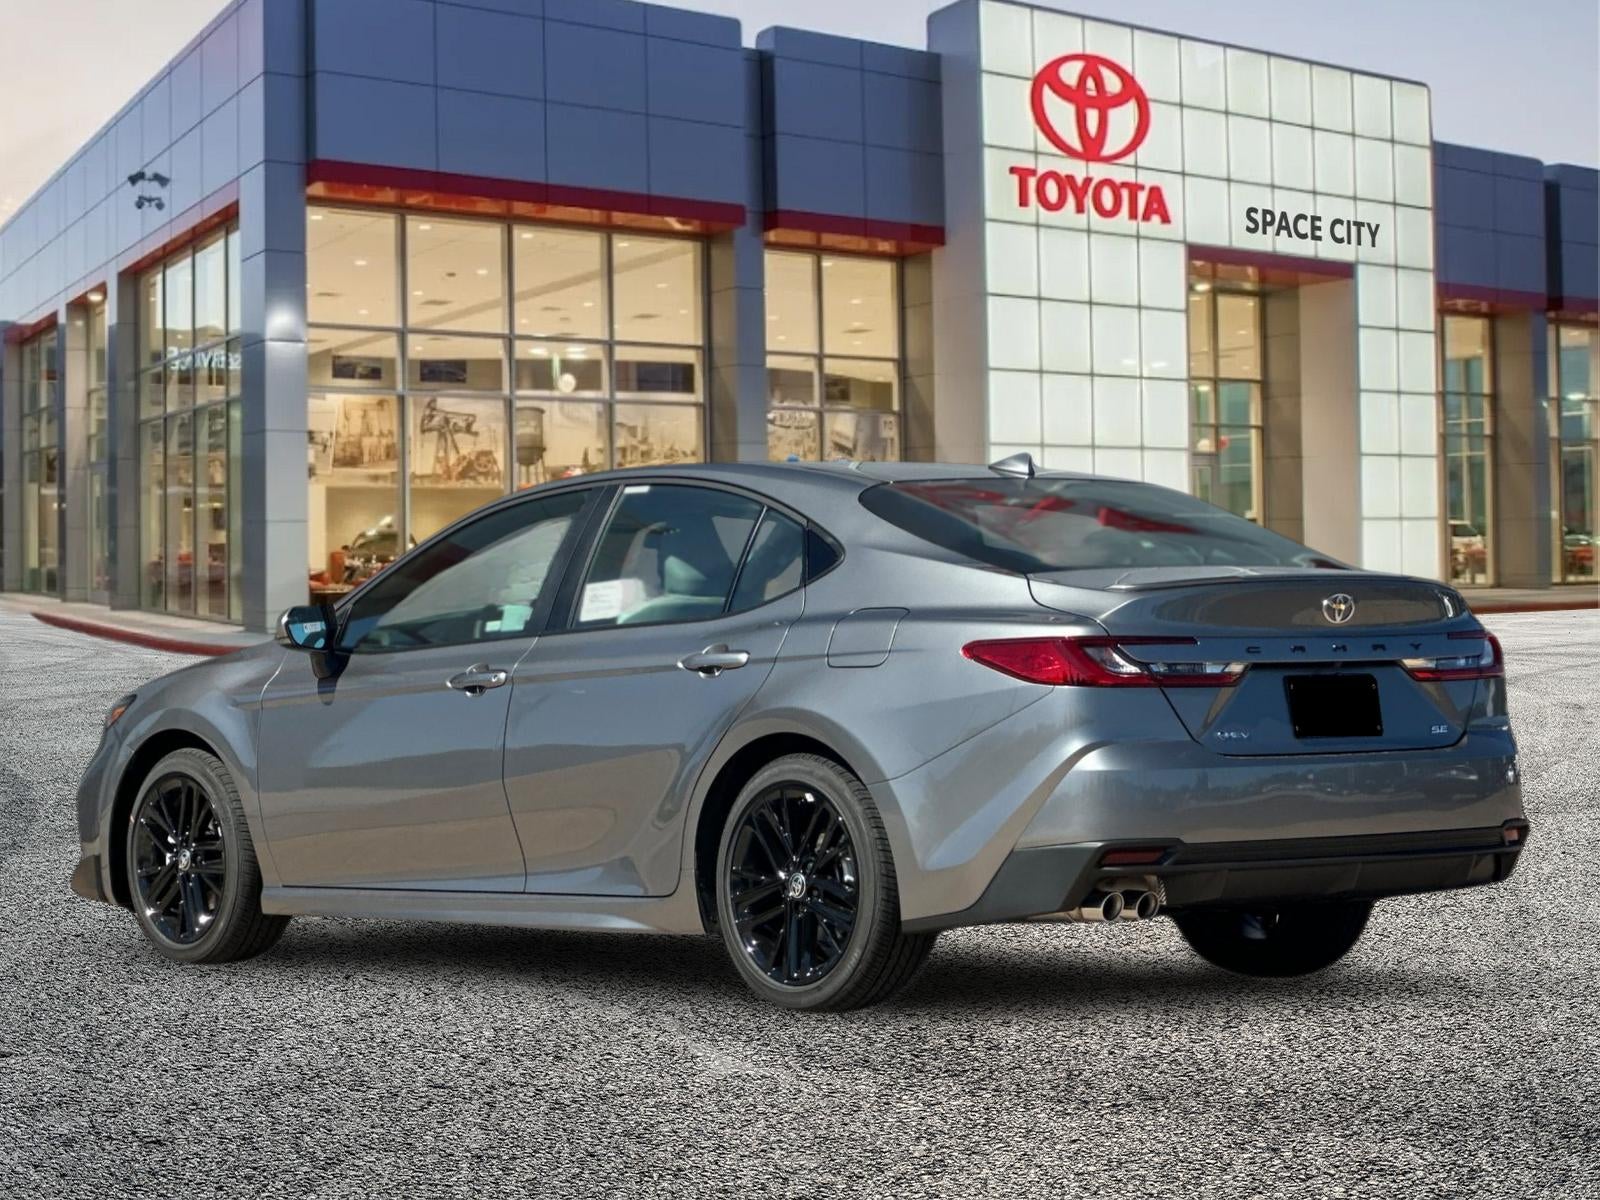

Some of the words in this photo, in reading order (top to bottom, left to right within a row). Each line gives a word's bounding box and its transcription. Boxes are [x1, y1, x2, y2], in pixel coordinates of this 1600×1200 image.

[1009, 166, 1171, 224] TOYOTA
[1245, 207, 1322, 241] SPACE
[1329, 218, 1380, 247] CITY
[1246, 642, 1422, 654] CAMRY
[1431, 725, 1448, 733] SE
